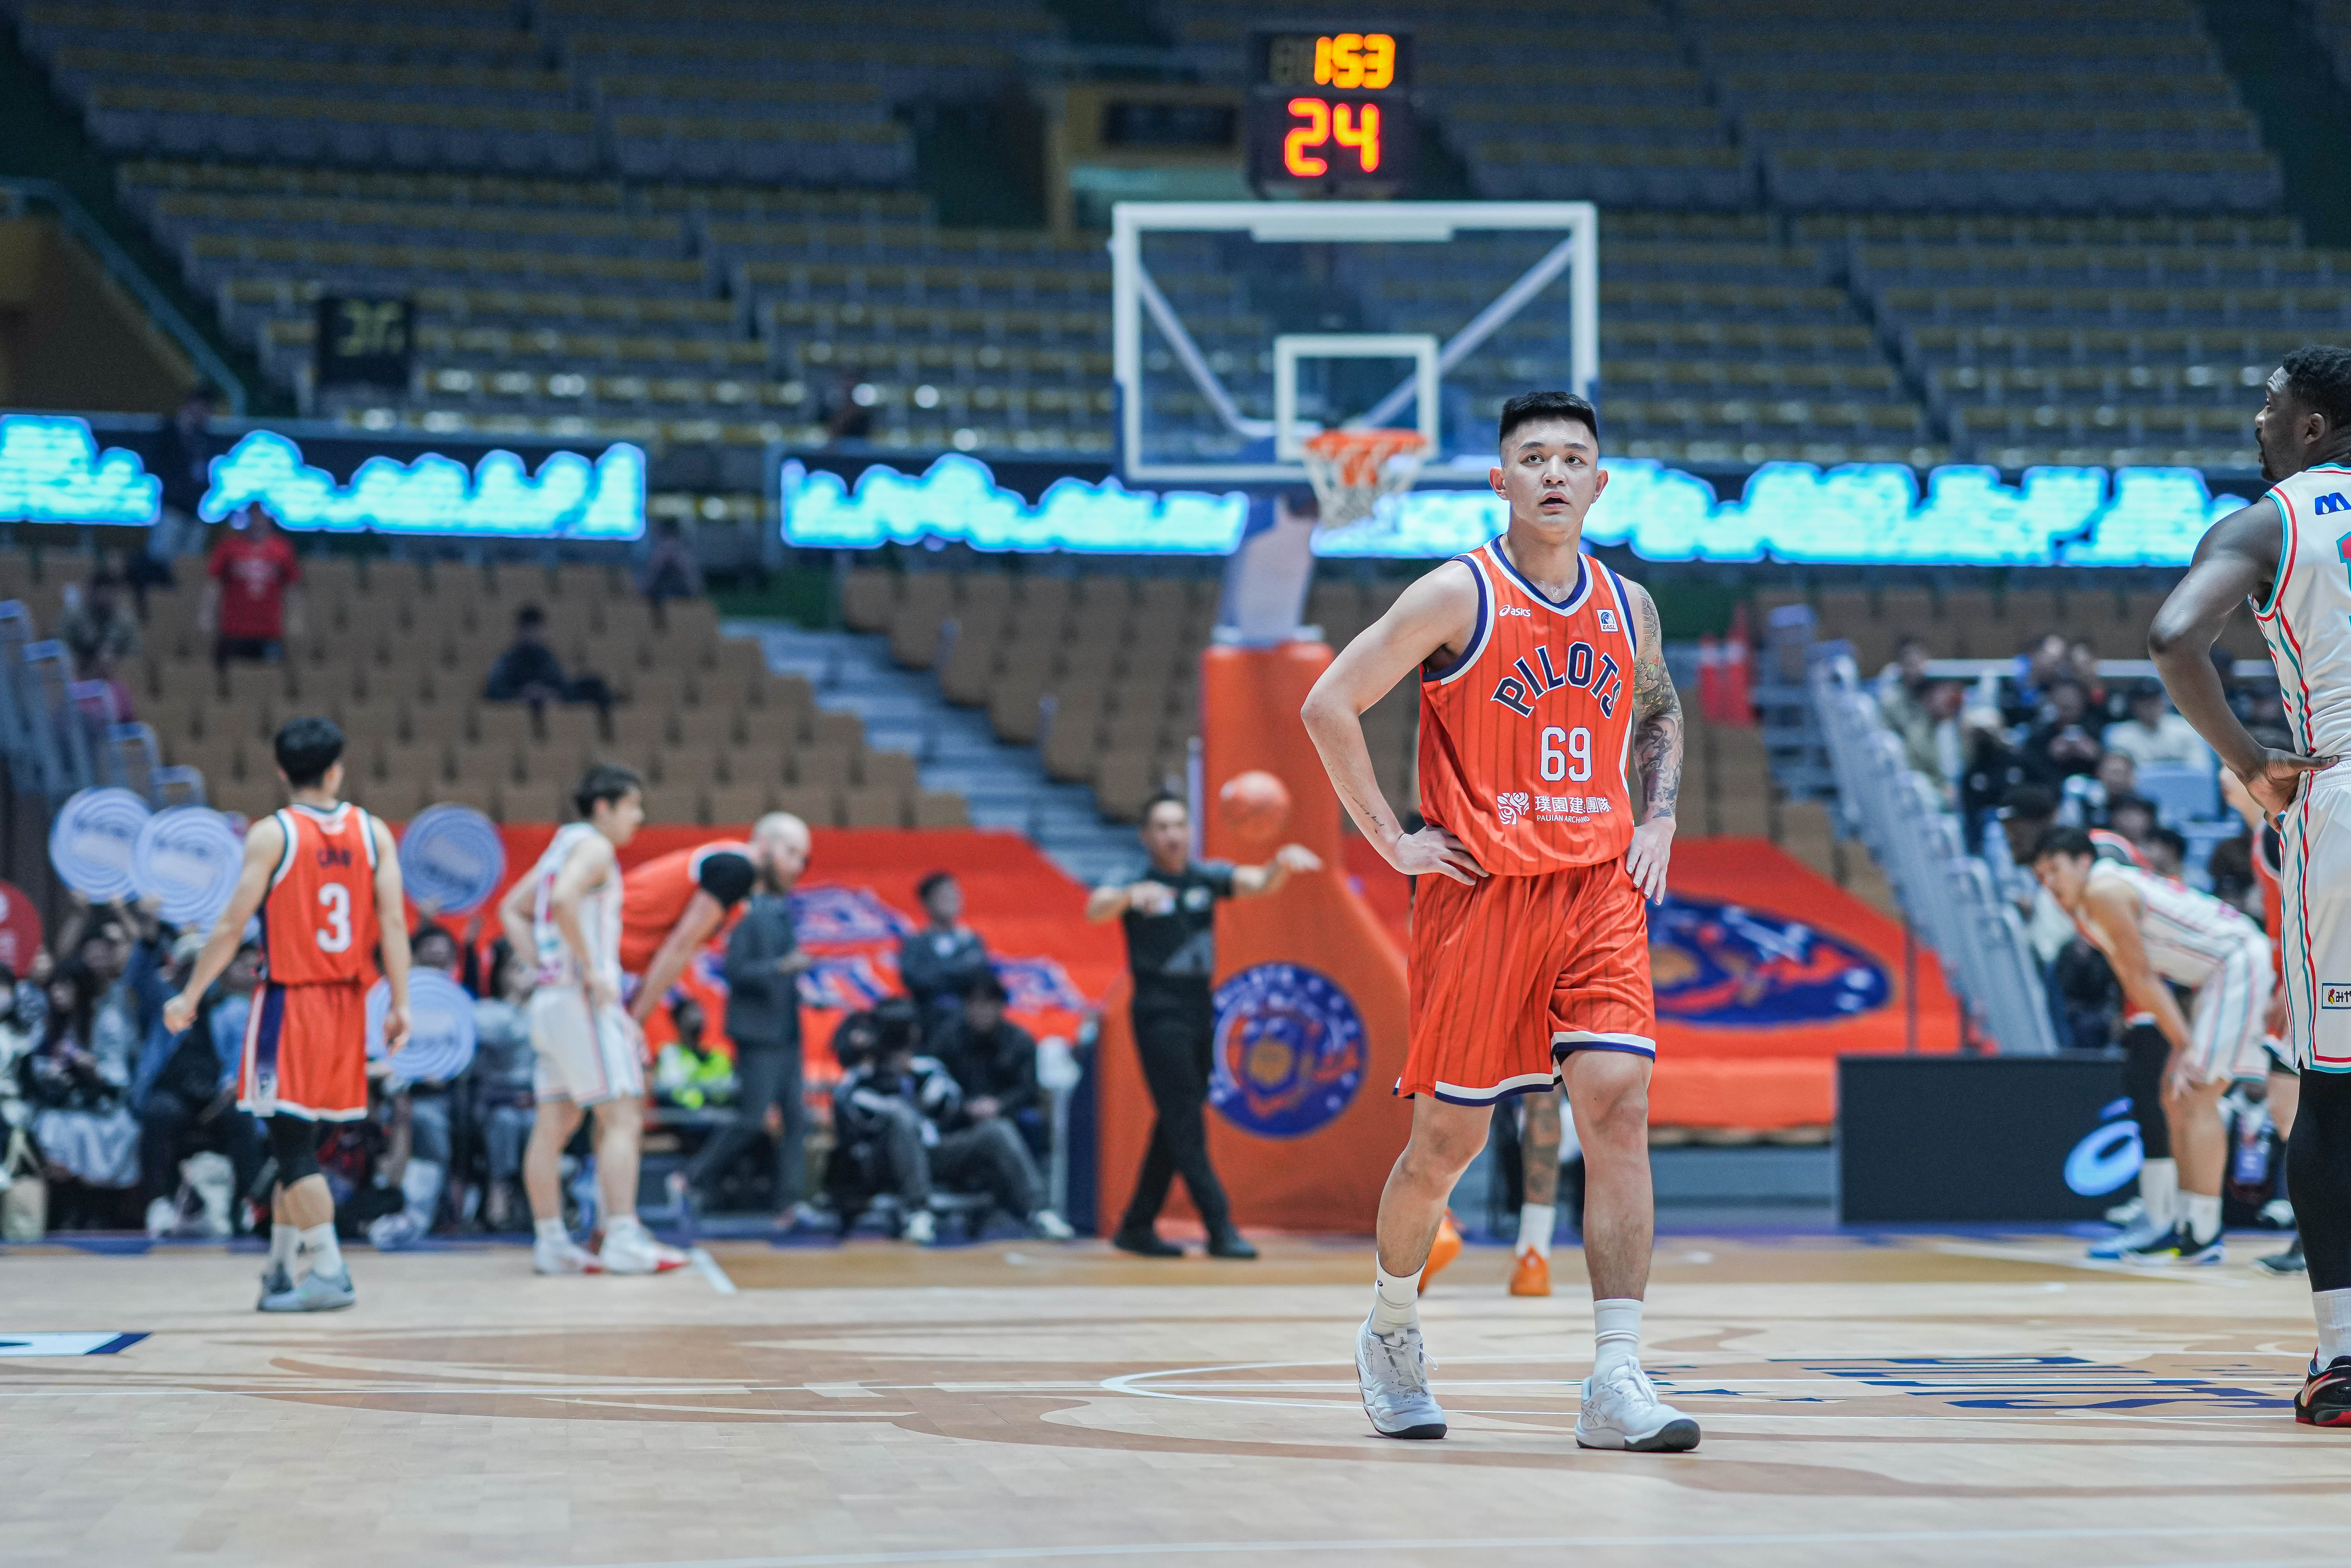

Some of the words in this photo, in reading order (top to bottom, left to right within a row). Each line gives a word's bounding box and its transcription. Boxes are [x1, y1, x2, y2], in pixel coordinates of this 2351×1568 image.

[1284, 98, 1380, 177] 24
[1510, 607, 1531, 617] asics
[1491, 641, 1622, 719] PILOTS
[1540, 726, 1592, 782] 69
[1535, 795, 1612, 814] 璞園建團隊
[316, 882, 352, 953] 3
